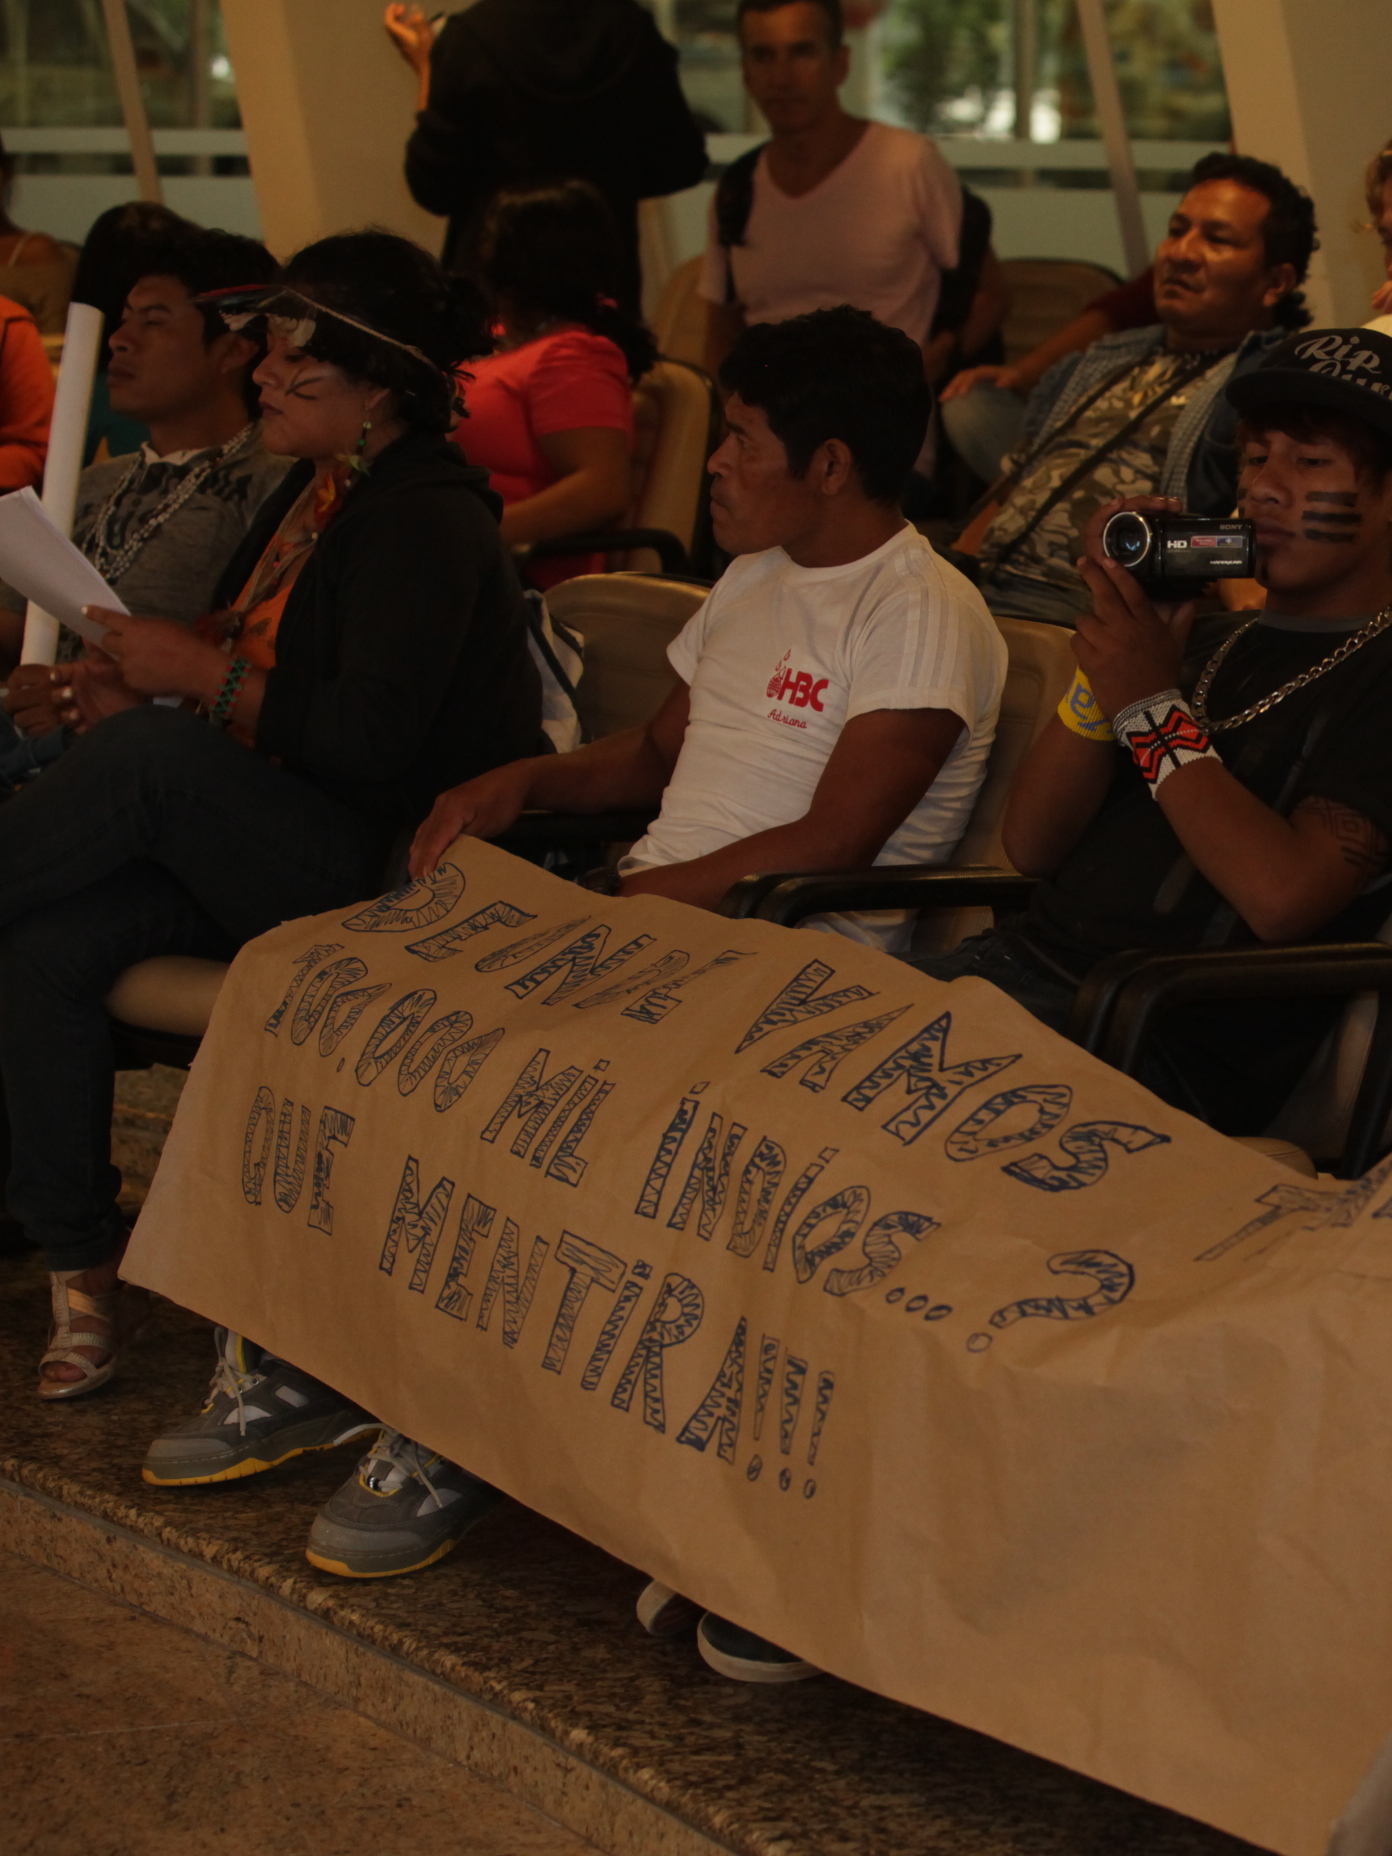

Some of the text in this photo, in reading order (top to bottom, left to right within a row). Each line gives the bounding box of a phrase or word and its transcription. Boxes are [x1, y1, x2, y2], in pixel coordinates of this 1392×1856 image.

[1294, 335, 1382, 374] Rip
[1166, 539, 1188, 549] HD
[1219, 523, 1243, 531] SONY
[777, 668, 829, 712] HBC
[767, 708, 807, 729] Adriana
[735, 959, 1171, 1192] VAMOS
[240, 1085, 356, 1237] QUE
